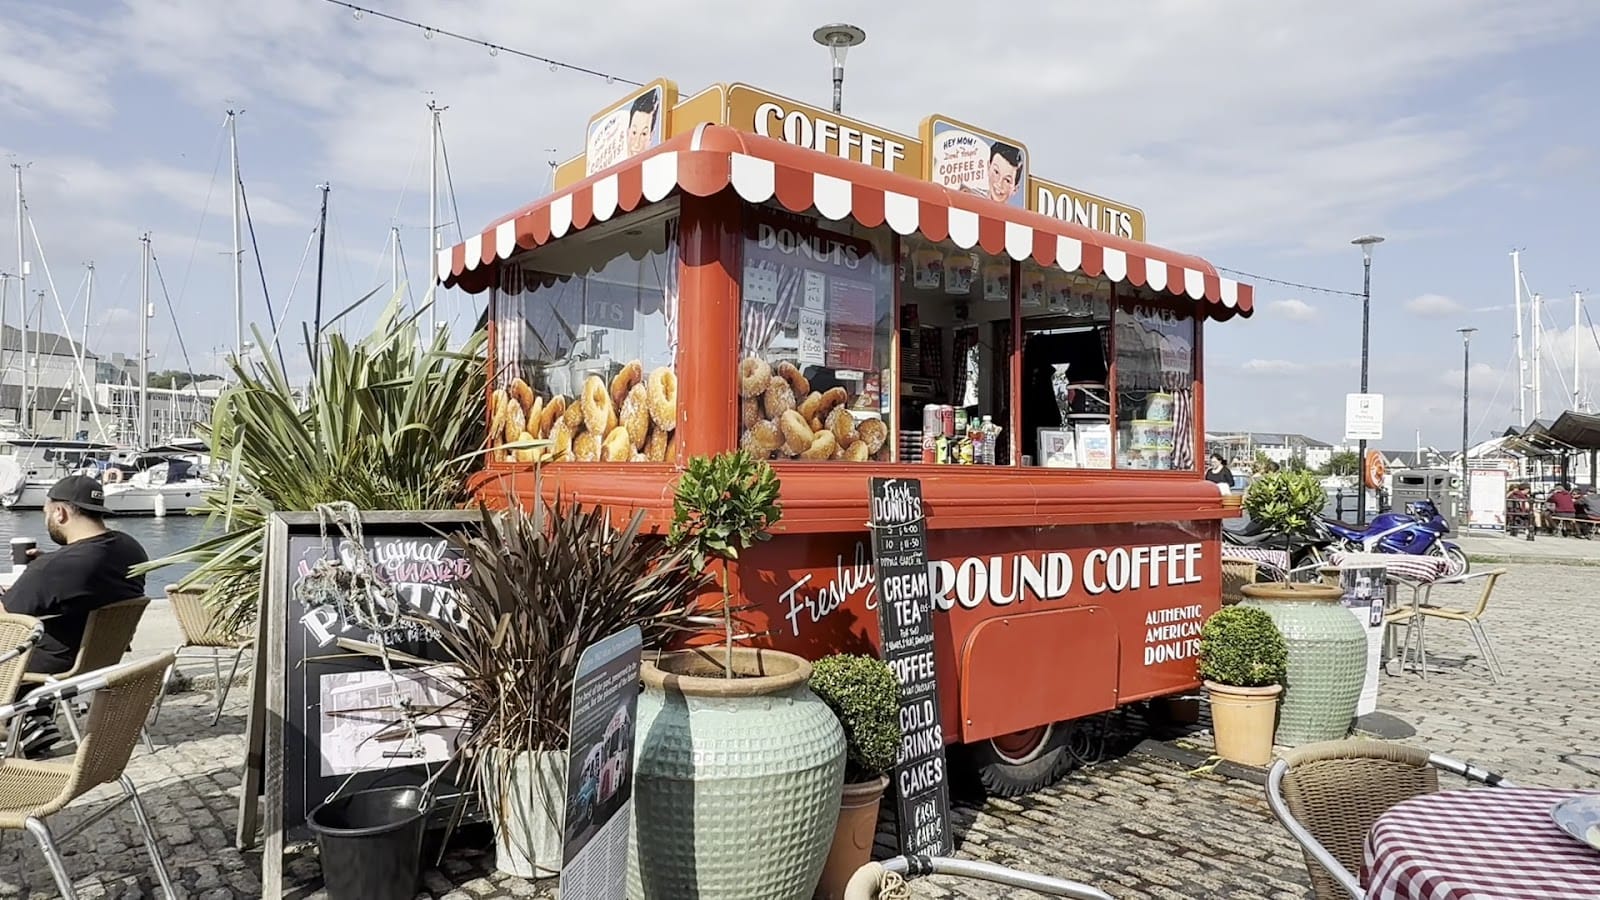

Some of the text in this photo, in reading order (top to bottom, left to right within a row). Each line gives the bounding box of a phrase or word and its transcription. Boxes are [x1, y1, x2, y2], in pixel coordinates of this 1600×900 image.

[943, 138, 955, 150] HEY
[939, 159, 985, 175] COFFEE &
[943, 169, 985, 186] DONUTS!
[758, 223, 860, 270] DONUTS
[874, 496, 922, 523] DONUTS
[885, 540, 894, 550] 10
[1082, 542, 1204, 594] COFFEE
[884, 572, 928, 603] CREAM
[894, 600, 922, 627] TEA
[1145, 604, 1202, 626] AUTHENTIC
[1145, 620, 1203, 644] AMERICAN
[1144, 637, 1202, 666] DONUTS
[899, 700, 935, 734] COLD
[896, 723, 943, 766] DRINKS
[900, 757, 943, 799] CAKES
